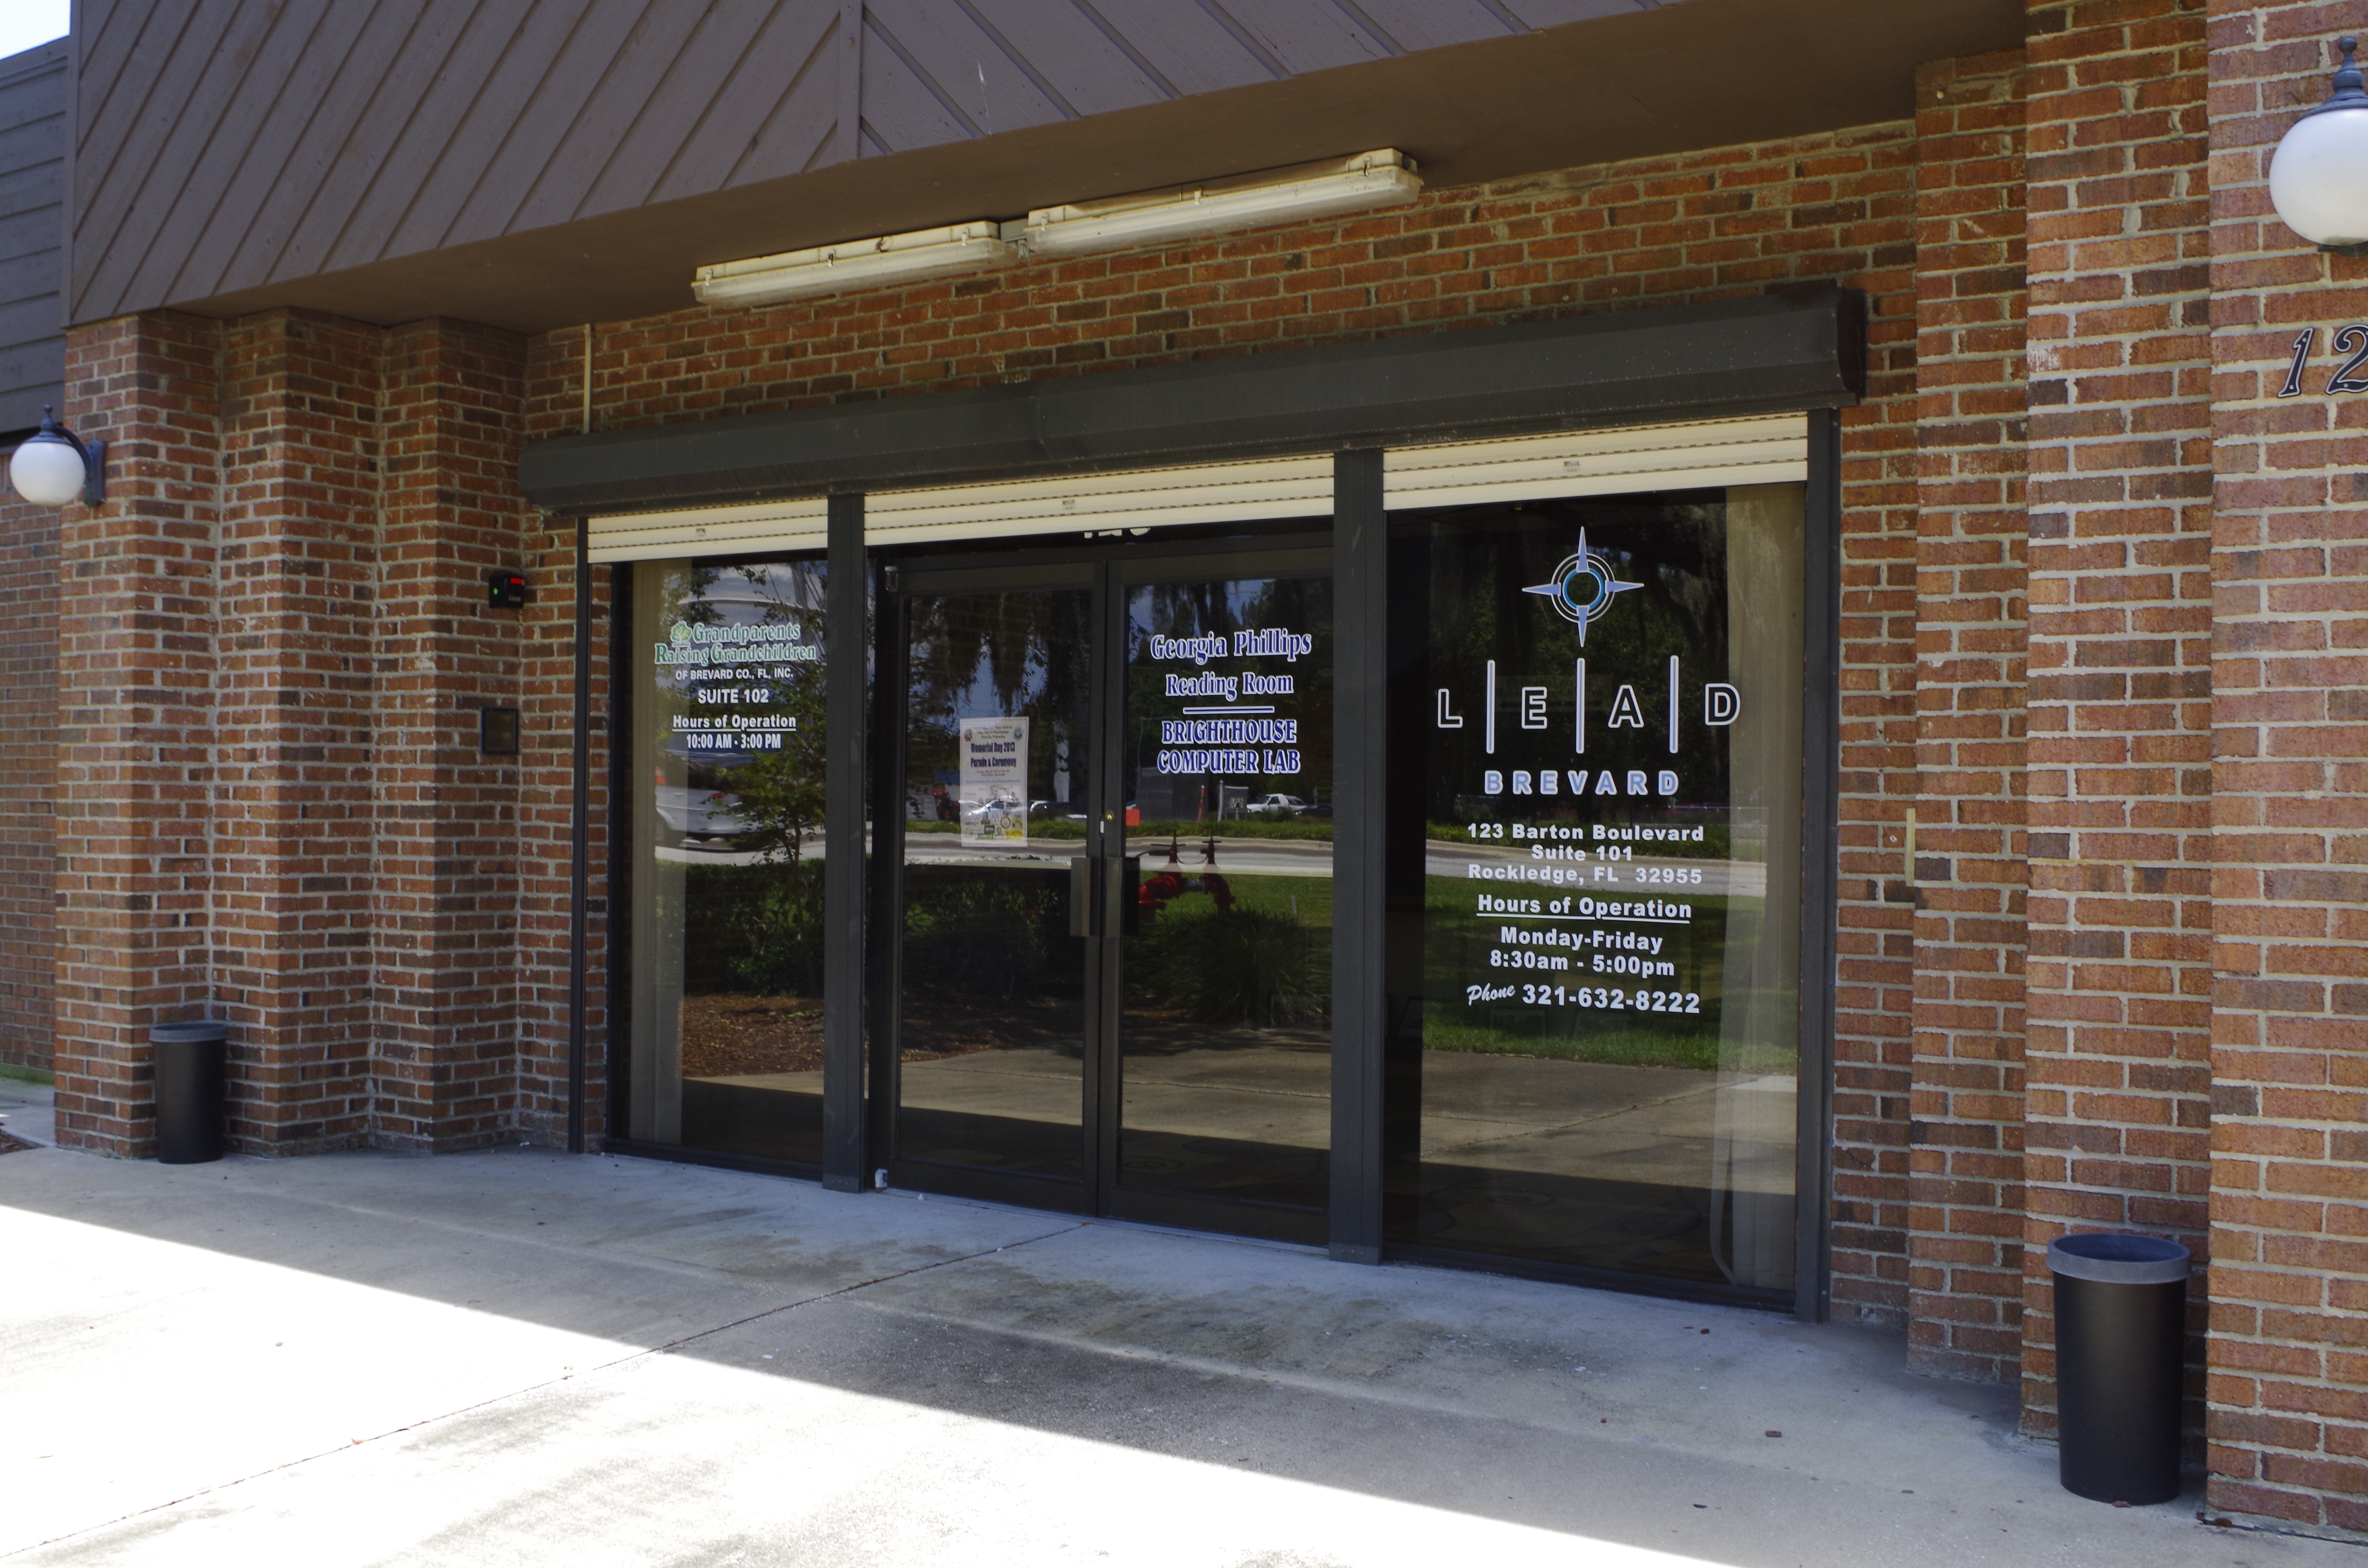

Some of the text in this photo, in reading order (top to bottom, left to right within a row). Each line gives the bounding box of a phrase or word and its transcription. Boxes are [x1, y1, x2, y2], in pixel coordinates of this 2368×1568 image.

[2277, 324, 2368, 398] 12
[692, 622, 801, 645] Grandparents
[654, 643, 816, 666] Raising Grandchildren
[1150, 628, 1312, 665] Georgia Phillips
[676, 670, 688, 680] OF
[690, 669, 733, 680] BREVARD
[774, 667, 793, 678] INC.
[698, 688, 769, 704] SUITE 102
[1165, 671, 1294, 702] Reading Room
[673, 714, 796, 731] Hours of Operation
[1161, 719, 1297, 744] BRIGHTHOUSE
[687, 734, 713, 749] 10:00
[715, 734, 732, 748] AM
[740, 734, 763, 748] 3:00
[765, 734, 781, 748] PM
[994, 742, 1003, 754] Day
[1157, 748, 1301, 774] COMPUTER LAB
[1484, 770, 1678, 795] BREVARD
[1468, 823, 1704, 842] 123 Barton Boulevard
[1531, 845, 1633, 862] Suite 101
[1468, 864, 1702, 886] Rockledge, FL 32955
[1478, 894, 1692, 919] Hours of Operation
[1501, 926, 1663, 955] Monday-Friday
[1490, 950, 1568, 970] 8:30am
[1592, 955, 1674, 979] 5:00pm
[1467, 982, 1700, 1014] Phone 321-632-8222
